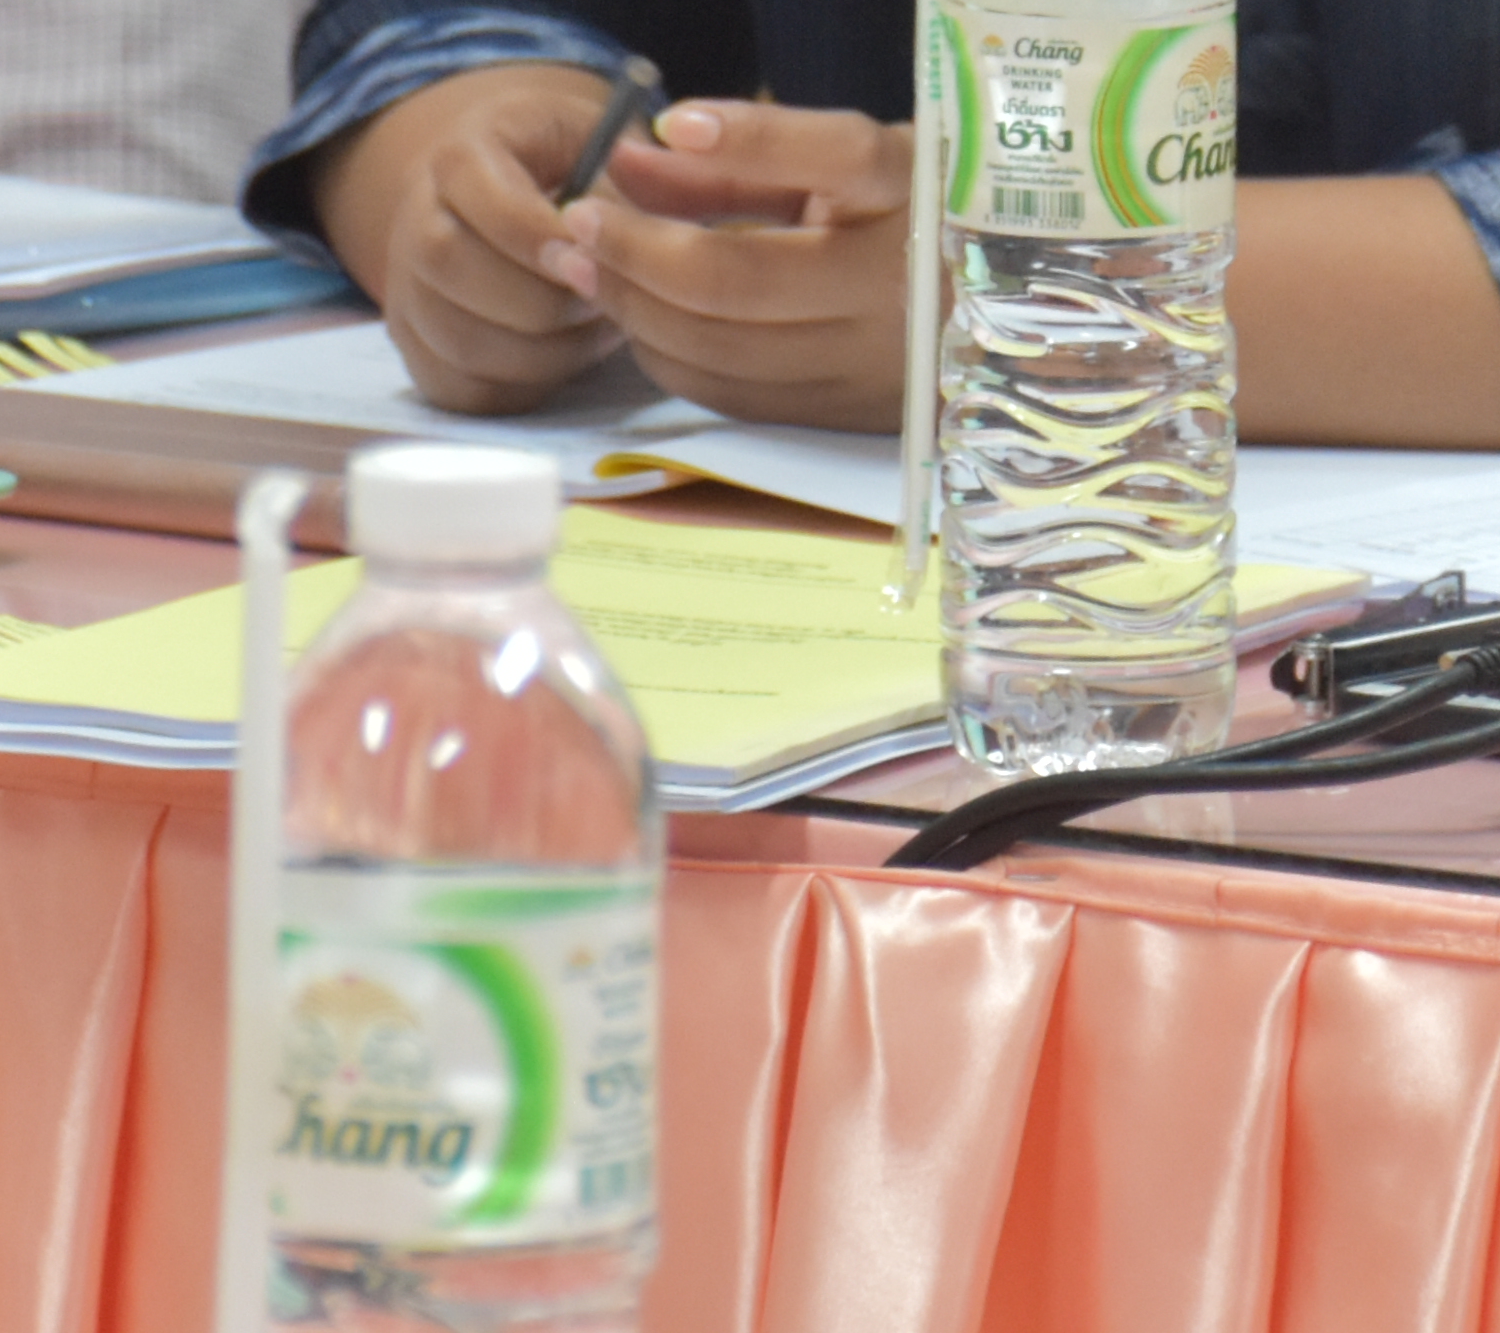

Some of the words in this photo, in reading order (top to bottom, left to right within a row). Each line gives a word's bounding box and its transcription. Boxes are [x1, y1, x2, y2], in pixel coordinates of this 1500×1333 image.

[1014, 37, 1084, 66] Chang
[1003, 65, 1062, 79] DRINKING
[1011, 80, 1053, 92] WATER
[1002, 97, 1066, 117] น้ำดื่มตรา
[995, 119, 1073, 152] ช้าง
[276, 1090, 478, 1188] hang
